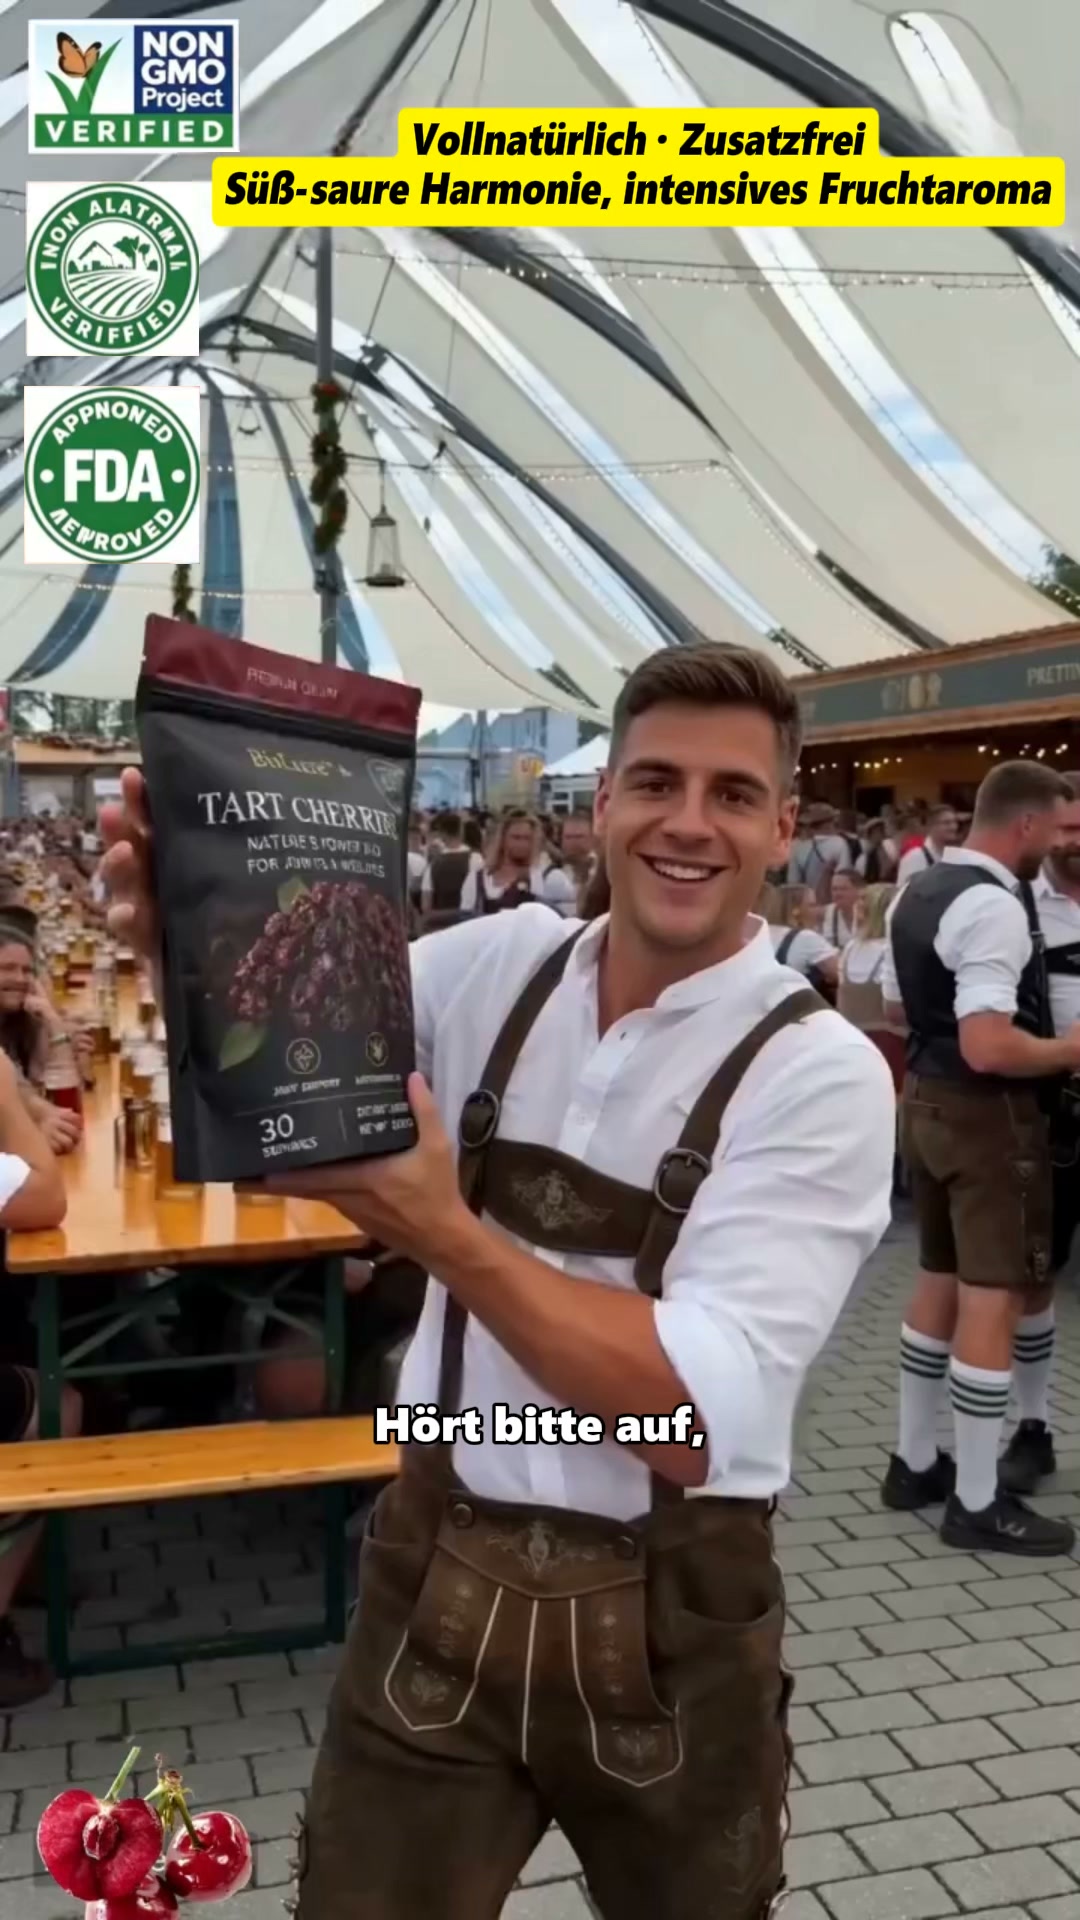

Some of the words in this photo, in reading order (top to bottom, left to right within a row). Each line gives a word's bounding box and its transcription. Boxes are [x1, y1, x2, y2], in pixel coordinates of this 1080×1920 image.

[198, 790, 286, 825] TART
[247, 858, 279, 875] FOR
[259, 1113, 294, 1143] 30
